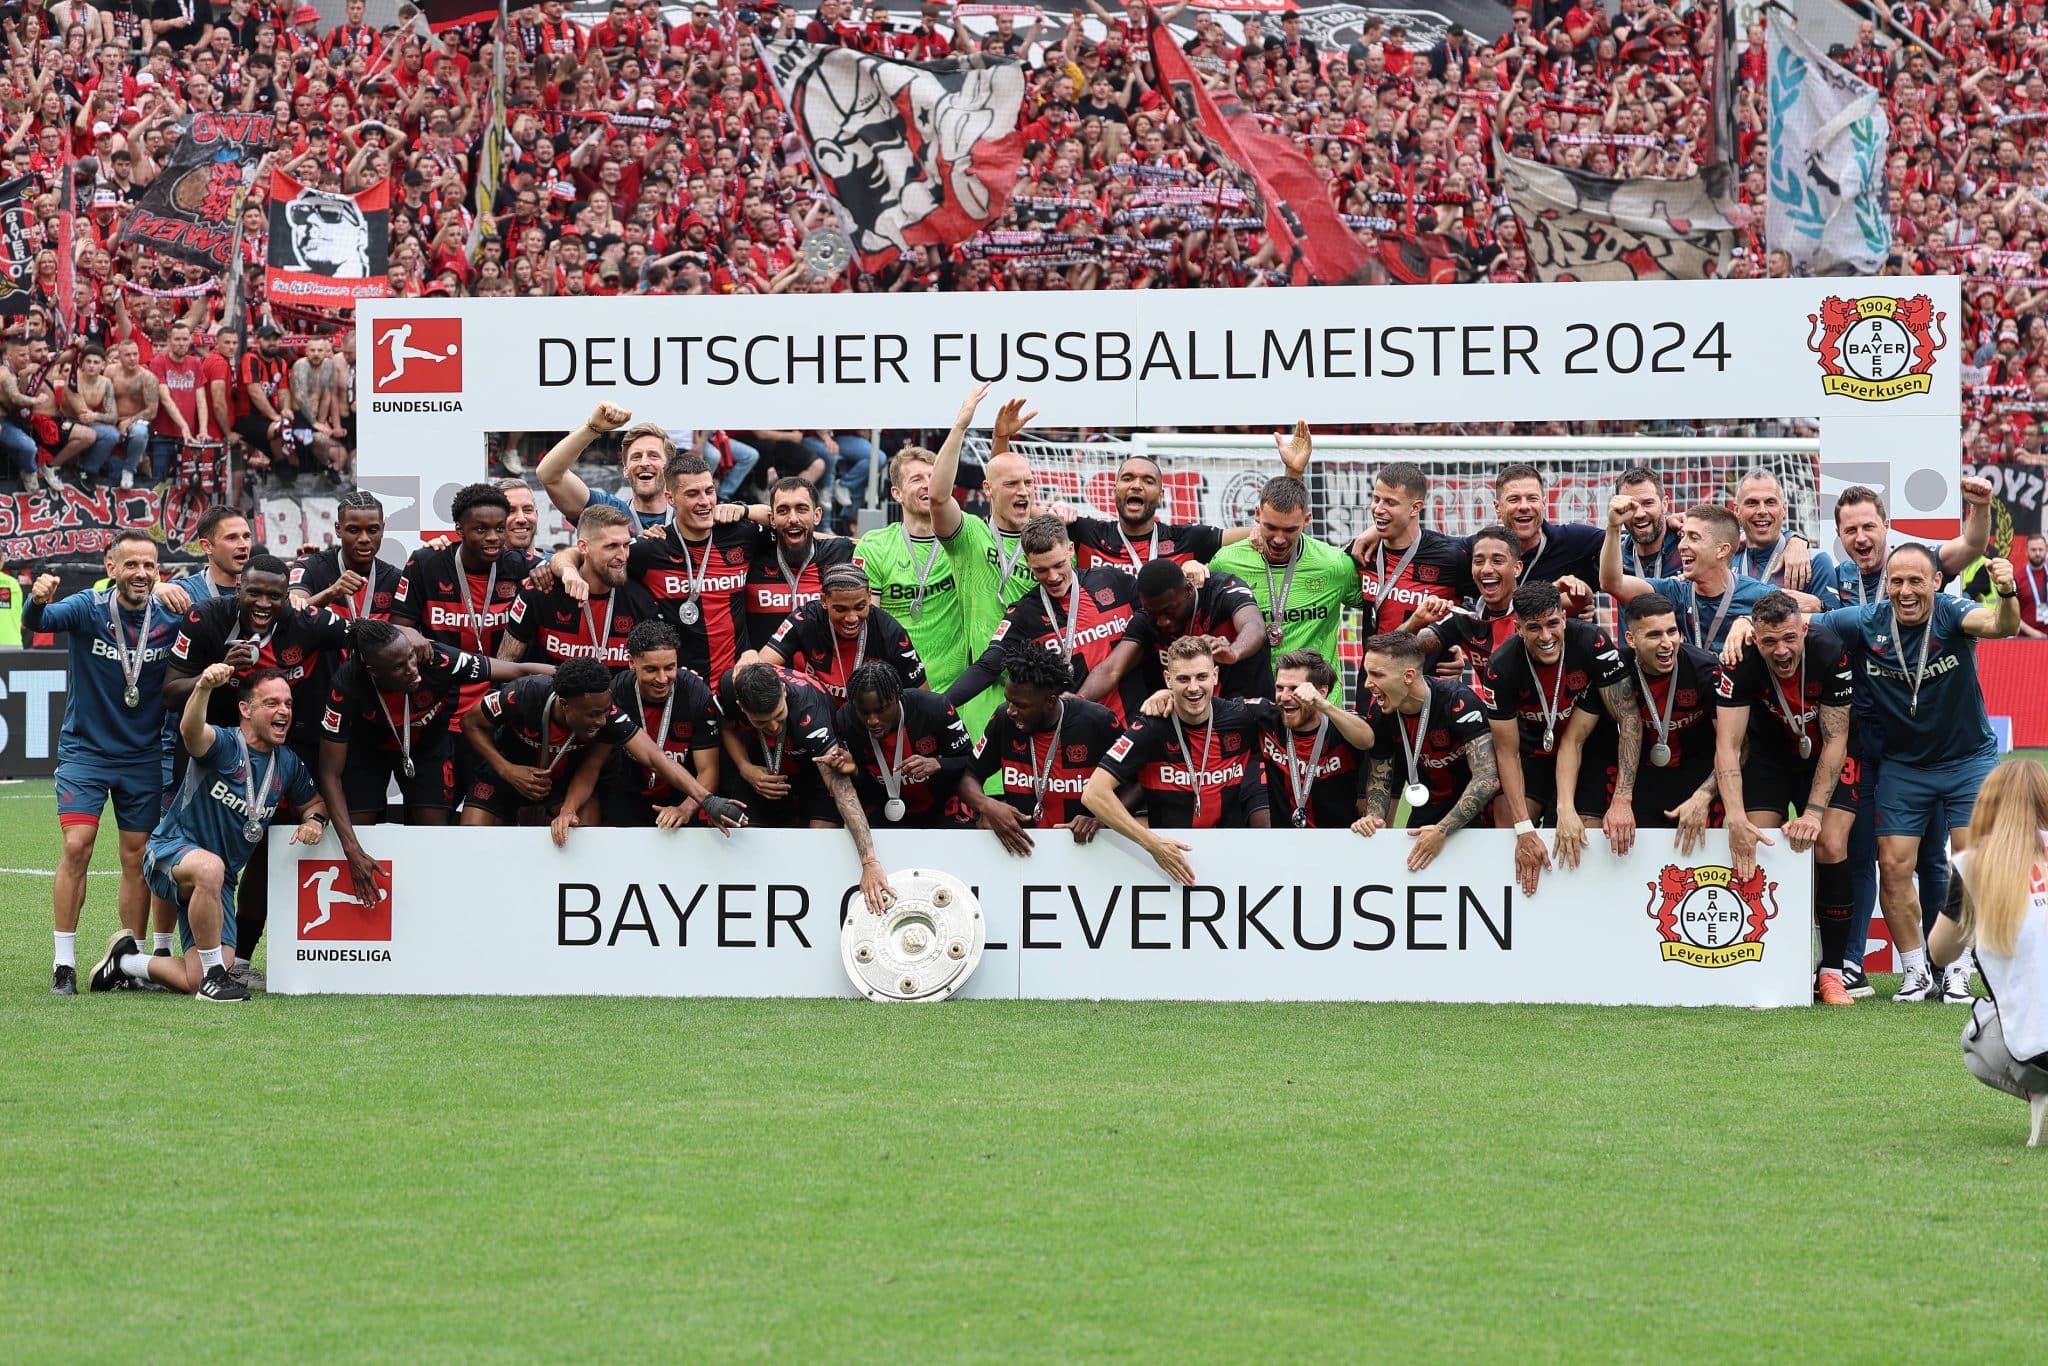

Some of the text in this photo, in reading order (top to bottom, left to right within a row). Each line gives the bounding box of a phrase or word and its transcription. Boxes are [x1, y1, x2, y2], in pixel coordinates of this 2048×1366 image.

[1860, 301, 1892, 314] 1904
[540, 322, 1732, 387] DEUTSCHER FUSSBALLMEISTER 2024
[1849, 343, 1905, 354] BAYER
[1871, 321, 1883, 377] BAYER
[1831, 378, 1923, 398] Leverkusen
[372, 401, 463, 413] BUNDESLIGA
[431, 606, 510, 628] Barmeni
[1045, 614, 1128, 655] Brmenia
[0, 670, 67, 759] T
[1697, 870, 1728, 882] 1904
[558, 884, 812, 948] BAYER
[1686, 912, 1740, 922] BAYER
[1707, 889, 1718, 945] BAYER
[297, 949, 392, 962] BUNDESLIGA
[1669, 945, 1756, 964] Leverkusen
